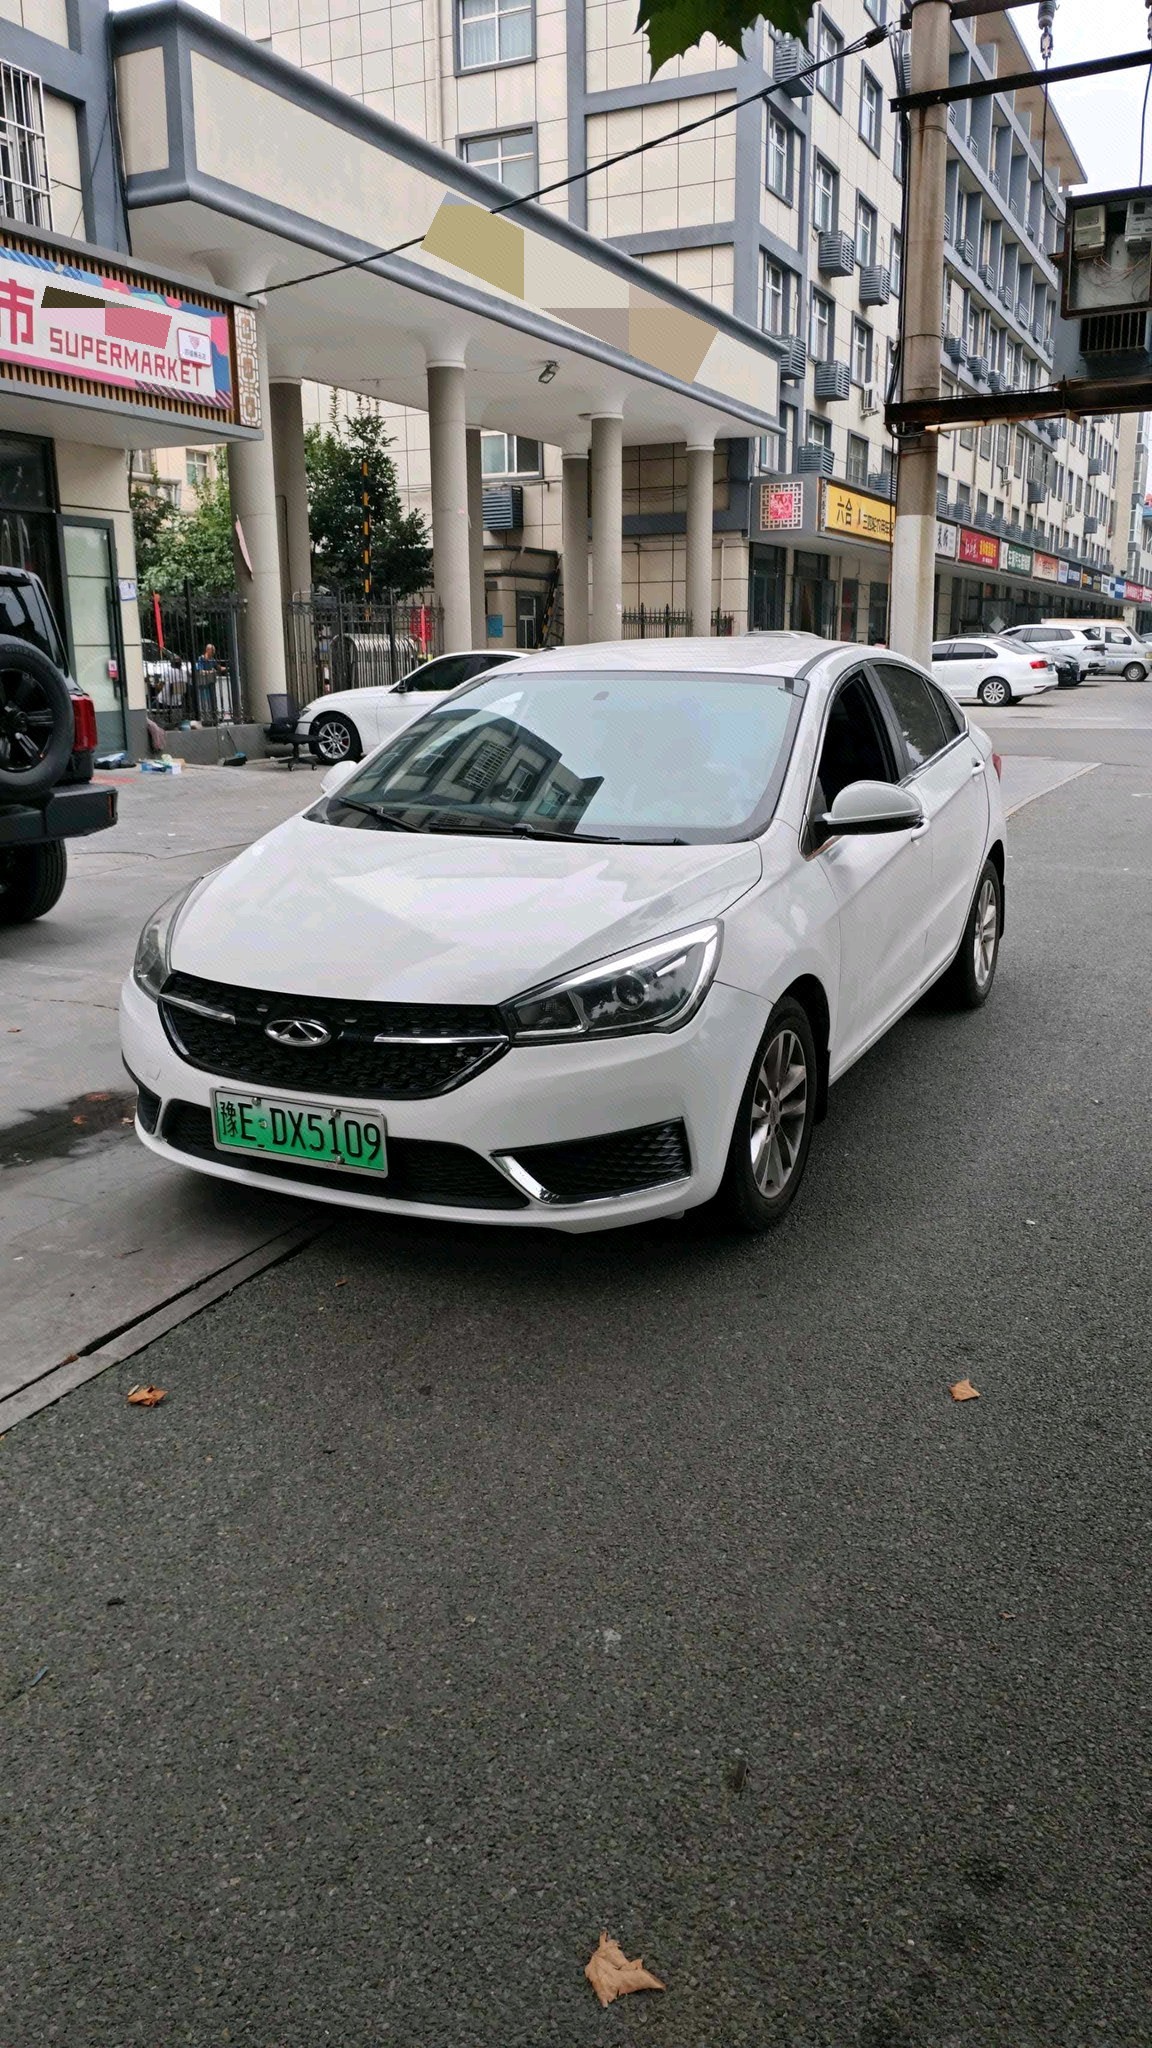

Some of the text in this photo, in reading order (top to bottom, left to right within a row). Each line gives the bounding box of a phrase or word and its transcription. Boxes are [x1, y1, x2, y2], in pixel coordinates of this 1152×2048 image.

[0, 278, 34, 345] 市
[50, 327, 203, 387] SUPERMARKET
[836, 495, 853, 526] 六合
